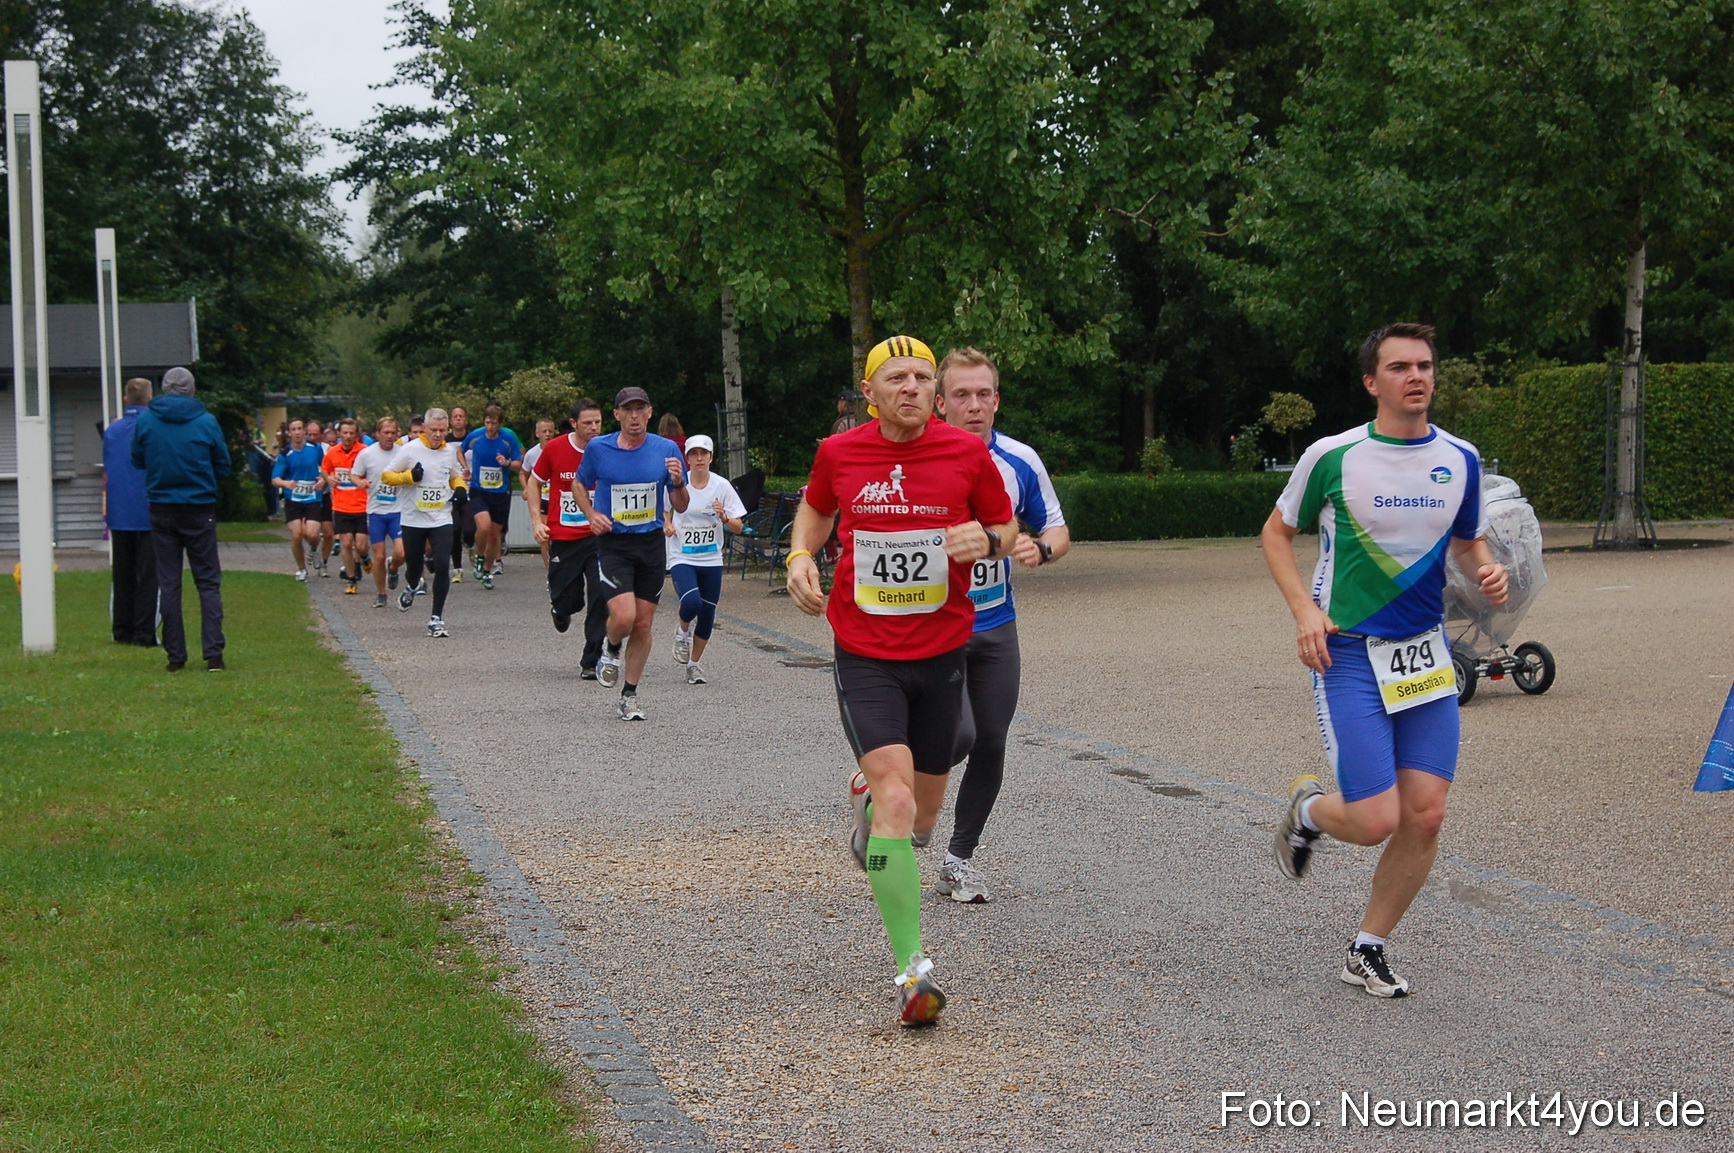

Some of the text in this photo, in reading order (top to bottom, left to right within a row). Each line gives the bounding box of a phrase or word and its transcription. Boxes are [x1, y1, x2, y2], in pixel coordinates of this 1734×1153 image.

[484, 472, 501, 481] 299
[422, 490, 441, 501] 526
[621, 493, 648, 510] 111
[1374, 496, 1445, 508] Sebastian
[852, 504, 949, 515] COMMITTED POWER
[684, 529, 715, 545] 2879
[856, 538, 930, 549] PARTL Neumarkt
[872, 551, 929, 584] 432
[878, 589, 926, 603] Gerhard
[969, 593, 988, 603] ian
[1390, 639, 1436, 677] 429
[1396, 675, 1447, 698] Sebastian
